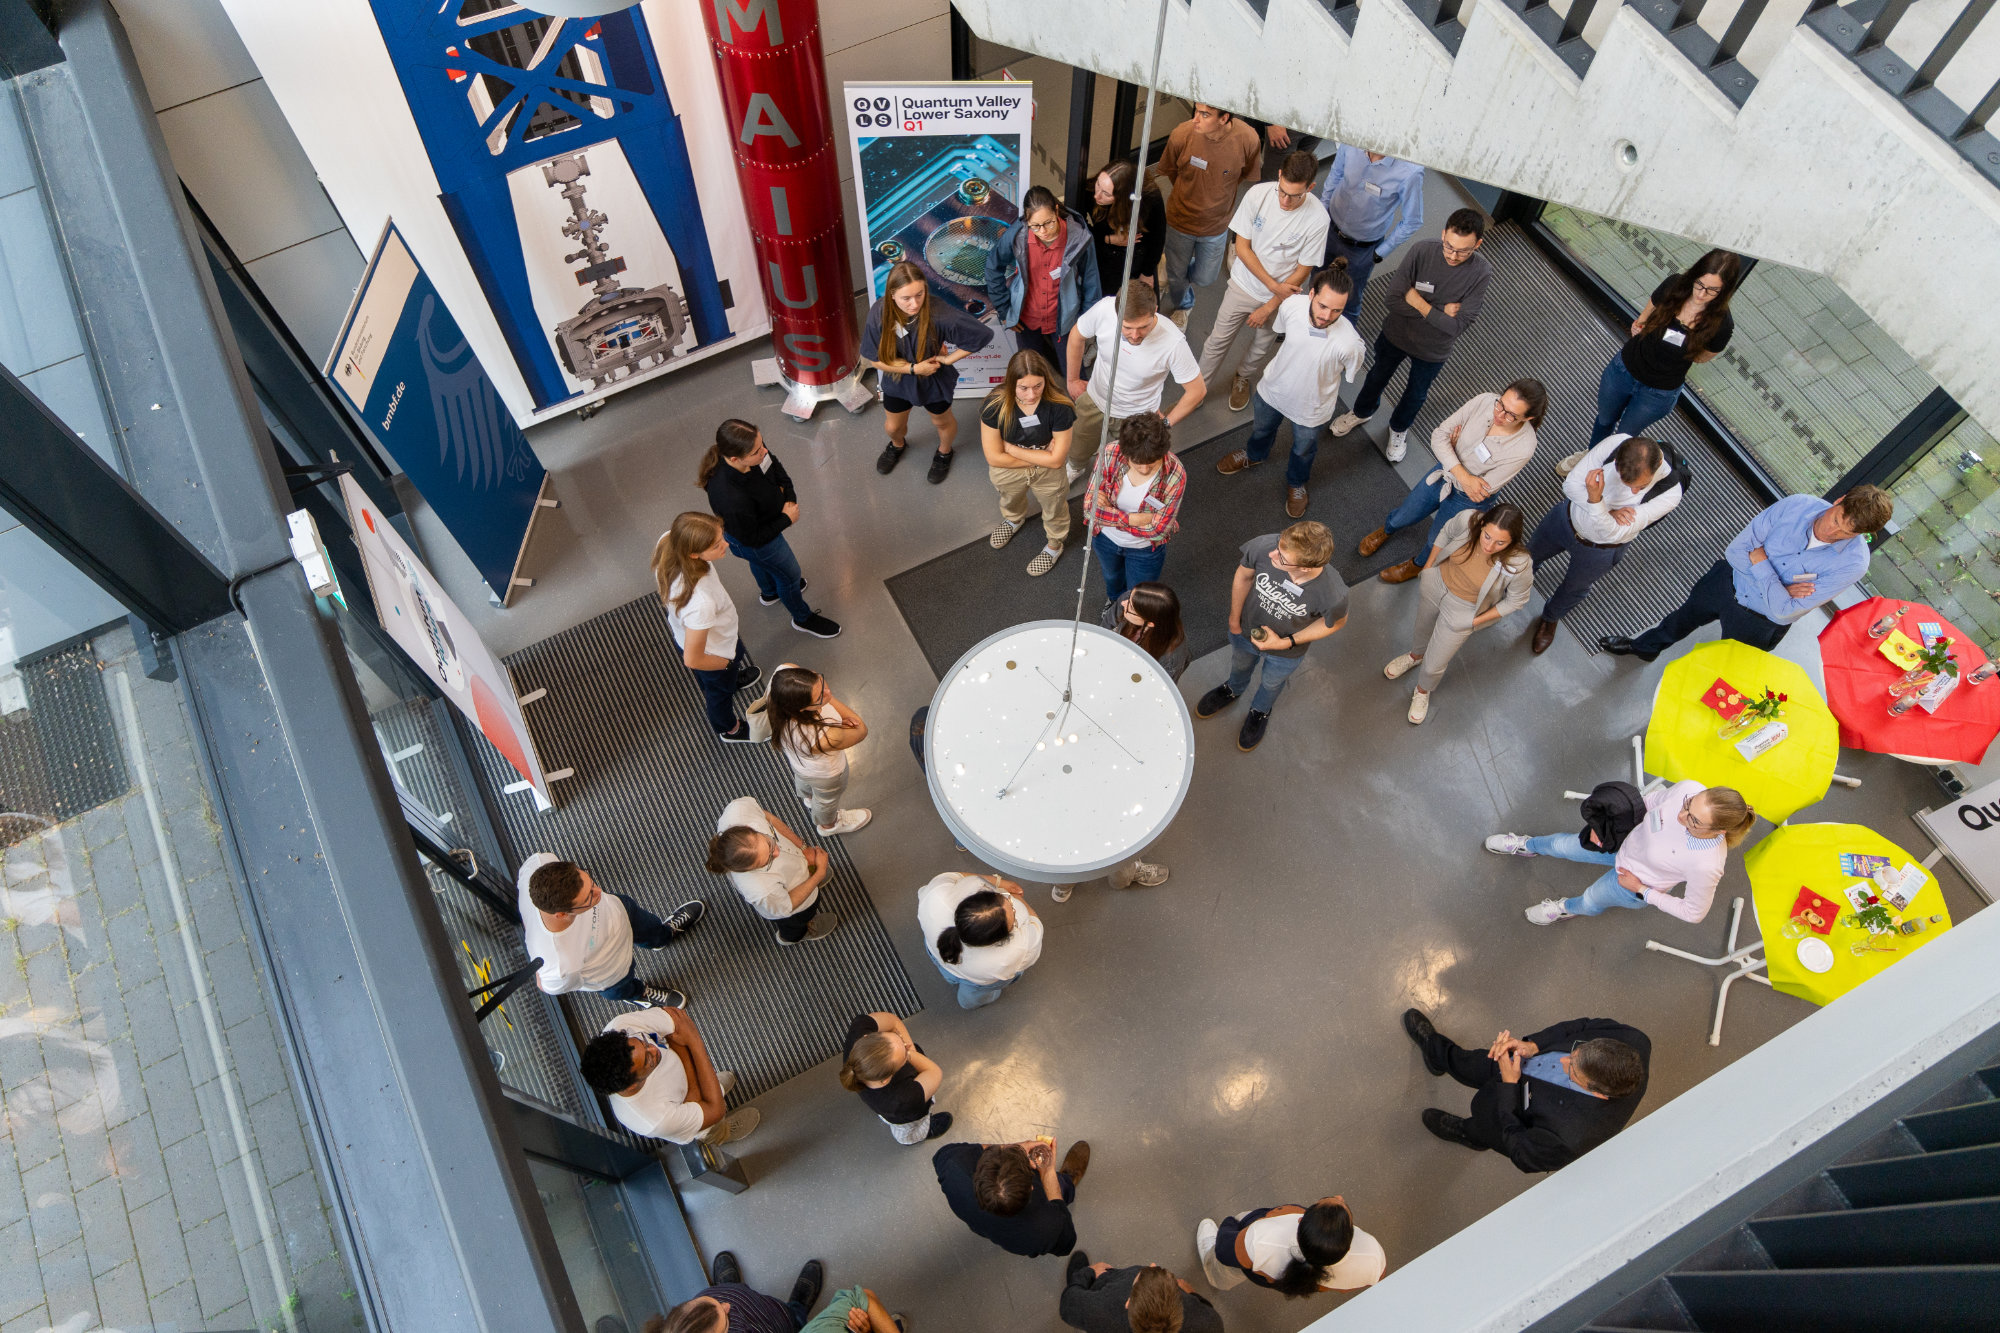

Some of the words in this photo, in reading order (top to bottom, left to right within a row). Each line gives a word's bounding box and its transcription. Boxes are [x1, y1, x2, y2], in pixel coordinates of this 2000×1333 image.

[902, 98, 972, 109] Quantum
[976, 96, 1021, 109] Valley
[904, 109, 950, 120] Lower
[954, 108, 1009, 121] Saxony
[904, 121, 923, 132] Q1
[714, 0, 831, 373] MAIUS
[382, 381, 406, 431] bmbf.de
[416, 590, 448, 683] Quantum
[1958, 797, 2000, 831] Qu
